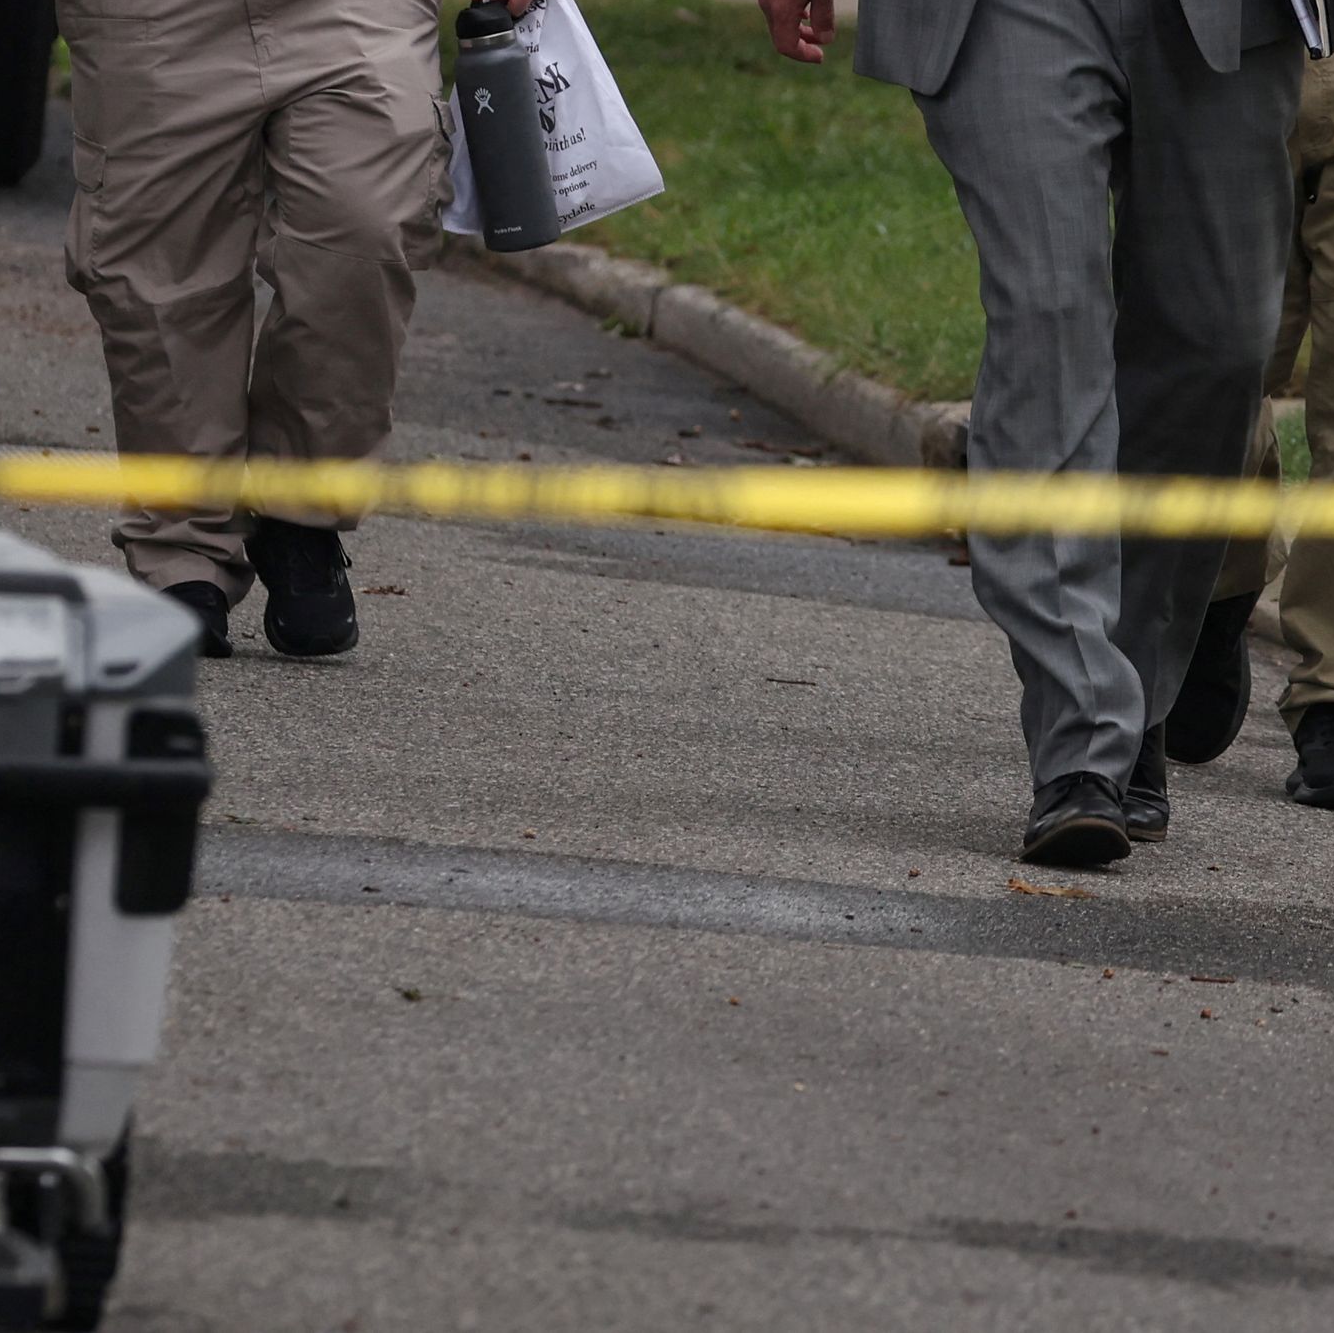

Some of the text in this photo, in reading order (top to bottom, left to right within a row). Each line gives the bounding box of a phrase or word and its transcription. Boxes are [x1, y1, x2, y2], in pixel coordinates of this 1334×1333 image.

[570, 127, 586, 145] us!
[569, 160, 597, 177] delivery
[558, 203, 596, 224] cyclable
